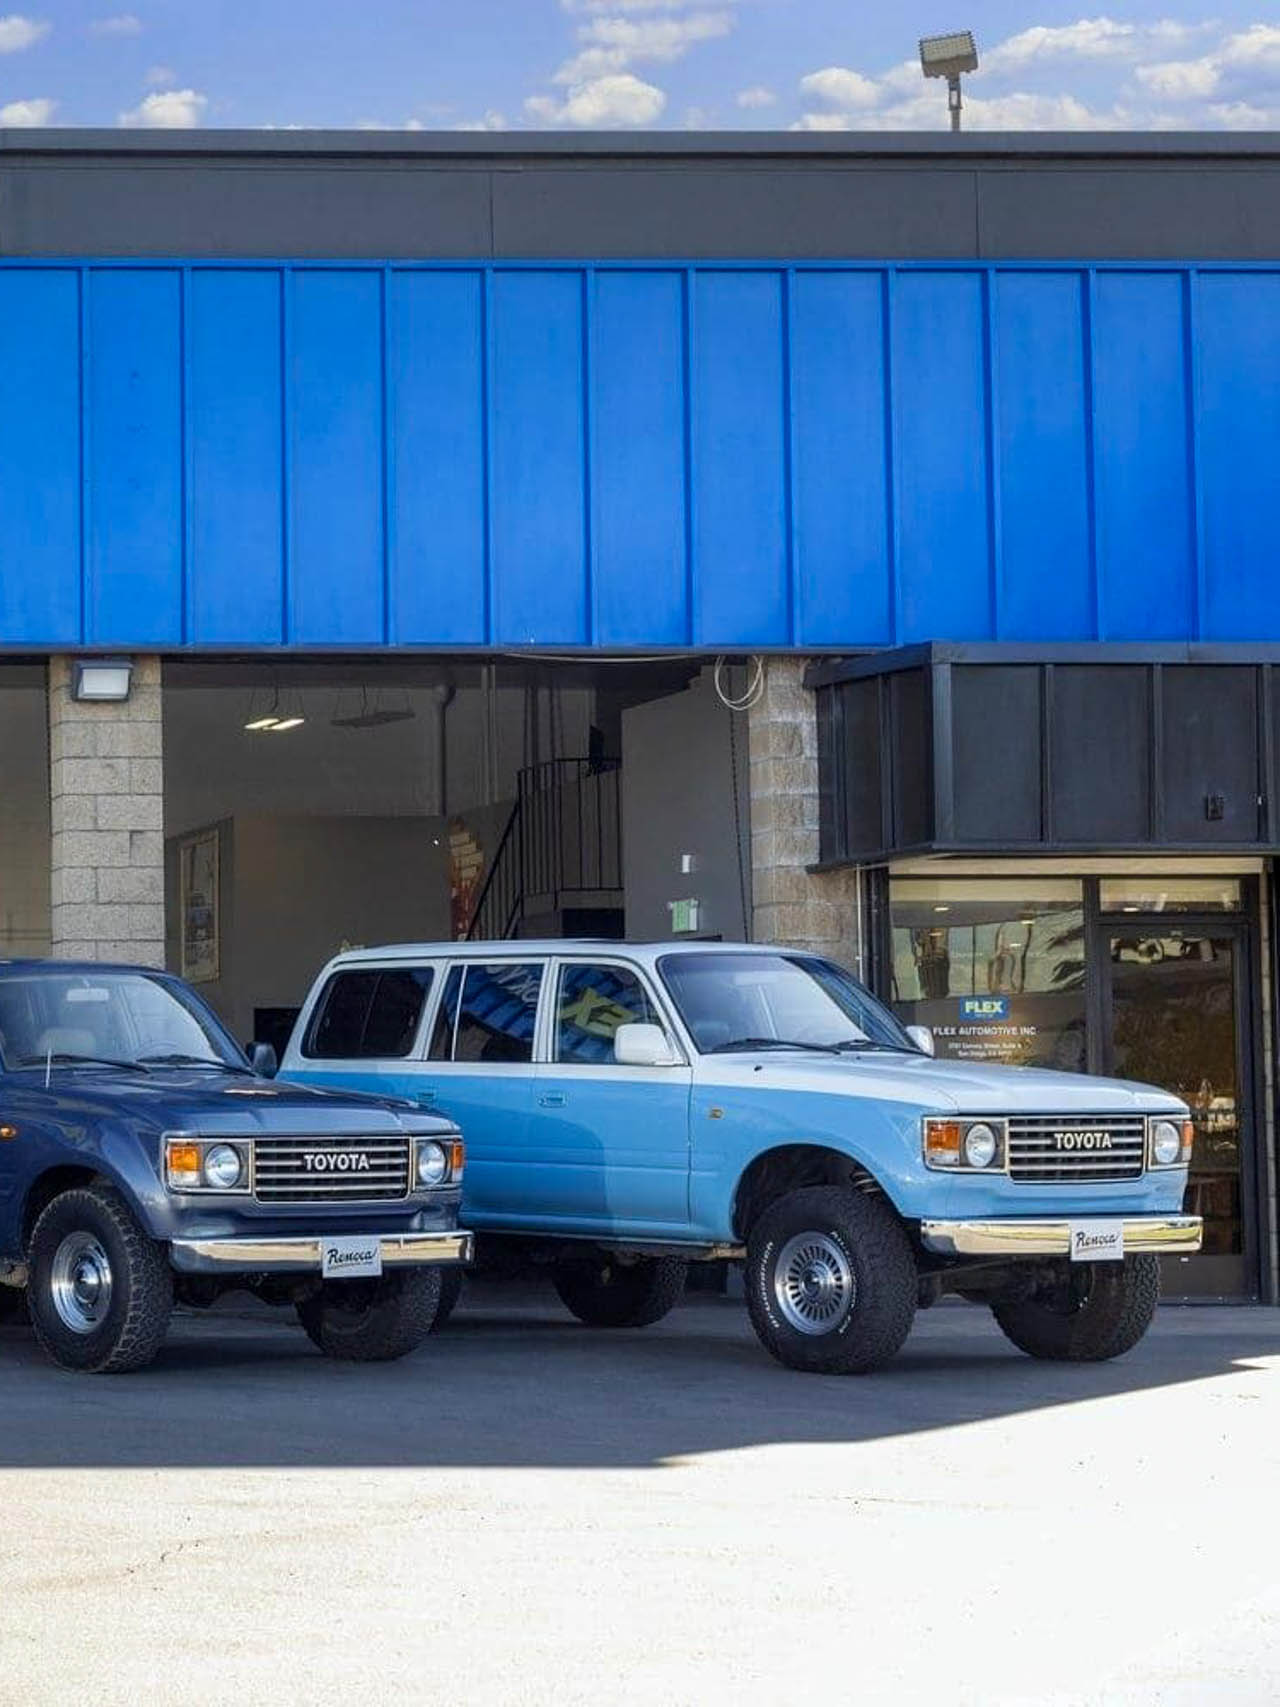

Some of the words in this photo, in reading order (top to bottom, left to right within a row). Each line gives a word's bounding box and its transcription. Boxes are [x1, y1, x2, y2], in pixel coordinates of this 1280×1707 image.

[965, 1001, 1004, 1013] FLEX
[933, 1027, 956, 1036] FLEX
[959, 1026, 1018, 1036] AUTOMOTIVE
[1053, 1132, 1113, 1150] TOYOTA
[303, 1153, 370, 1171] TOYOTA
